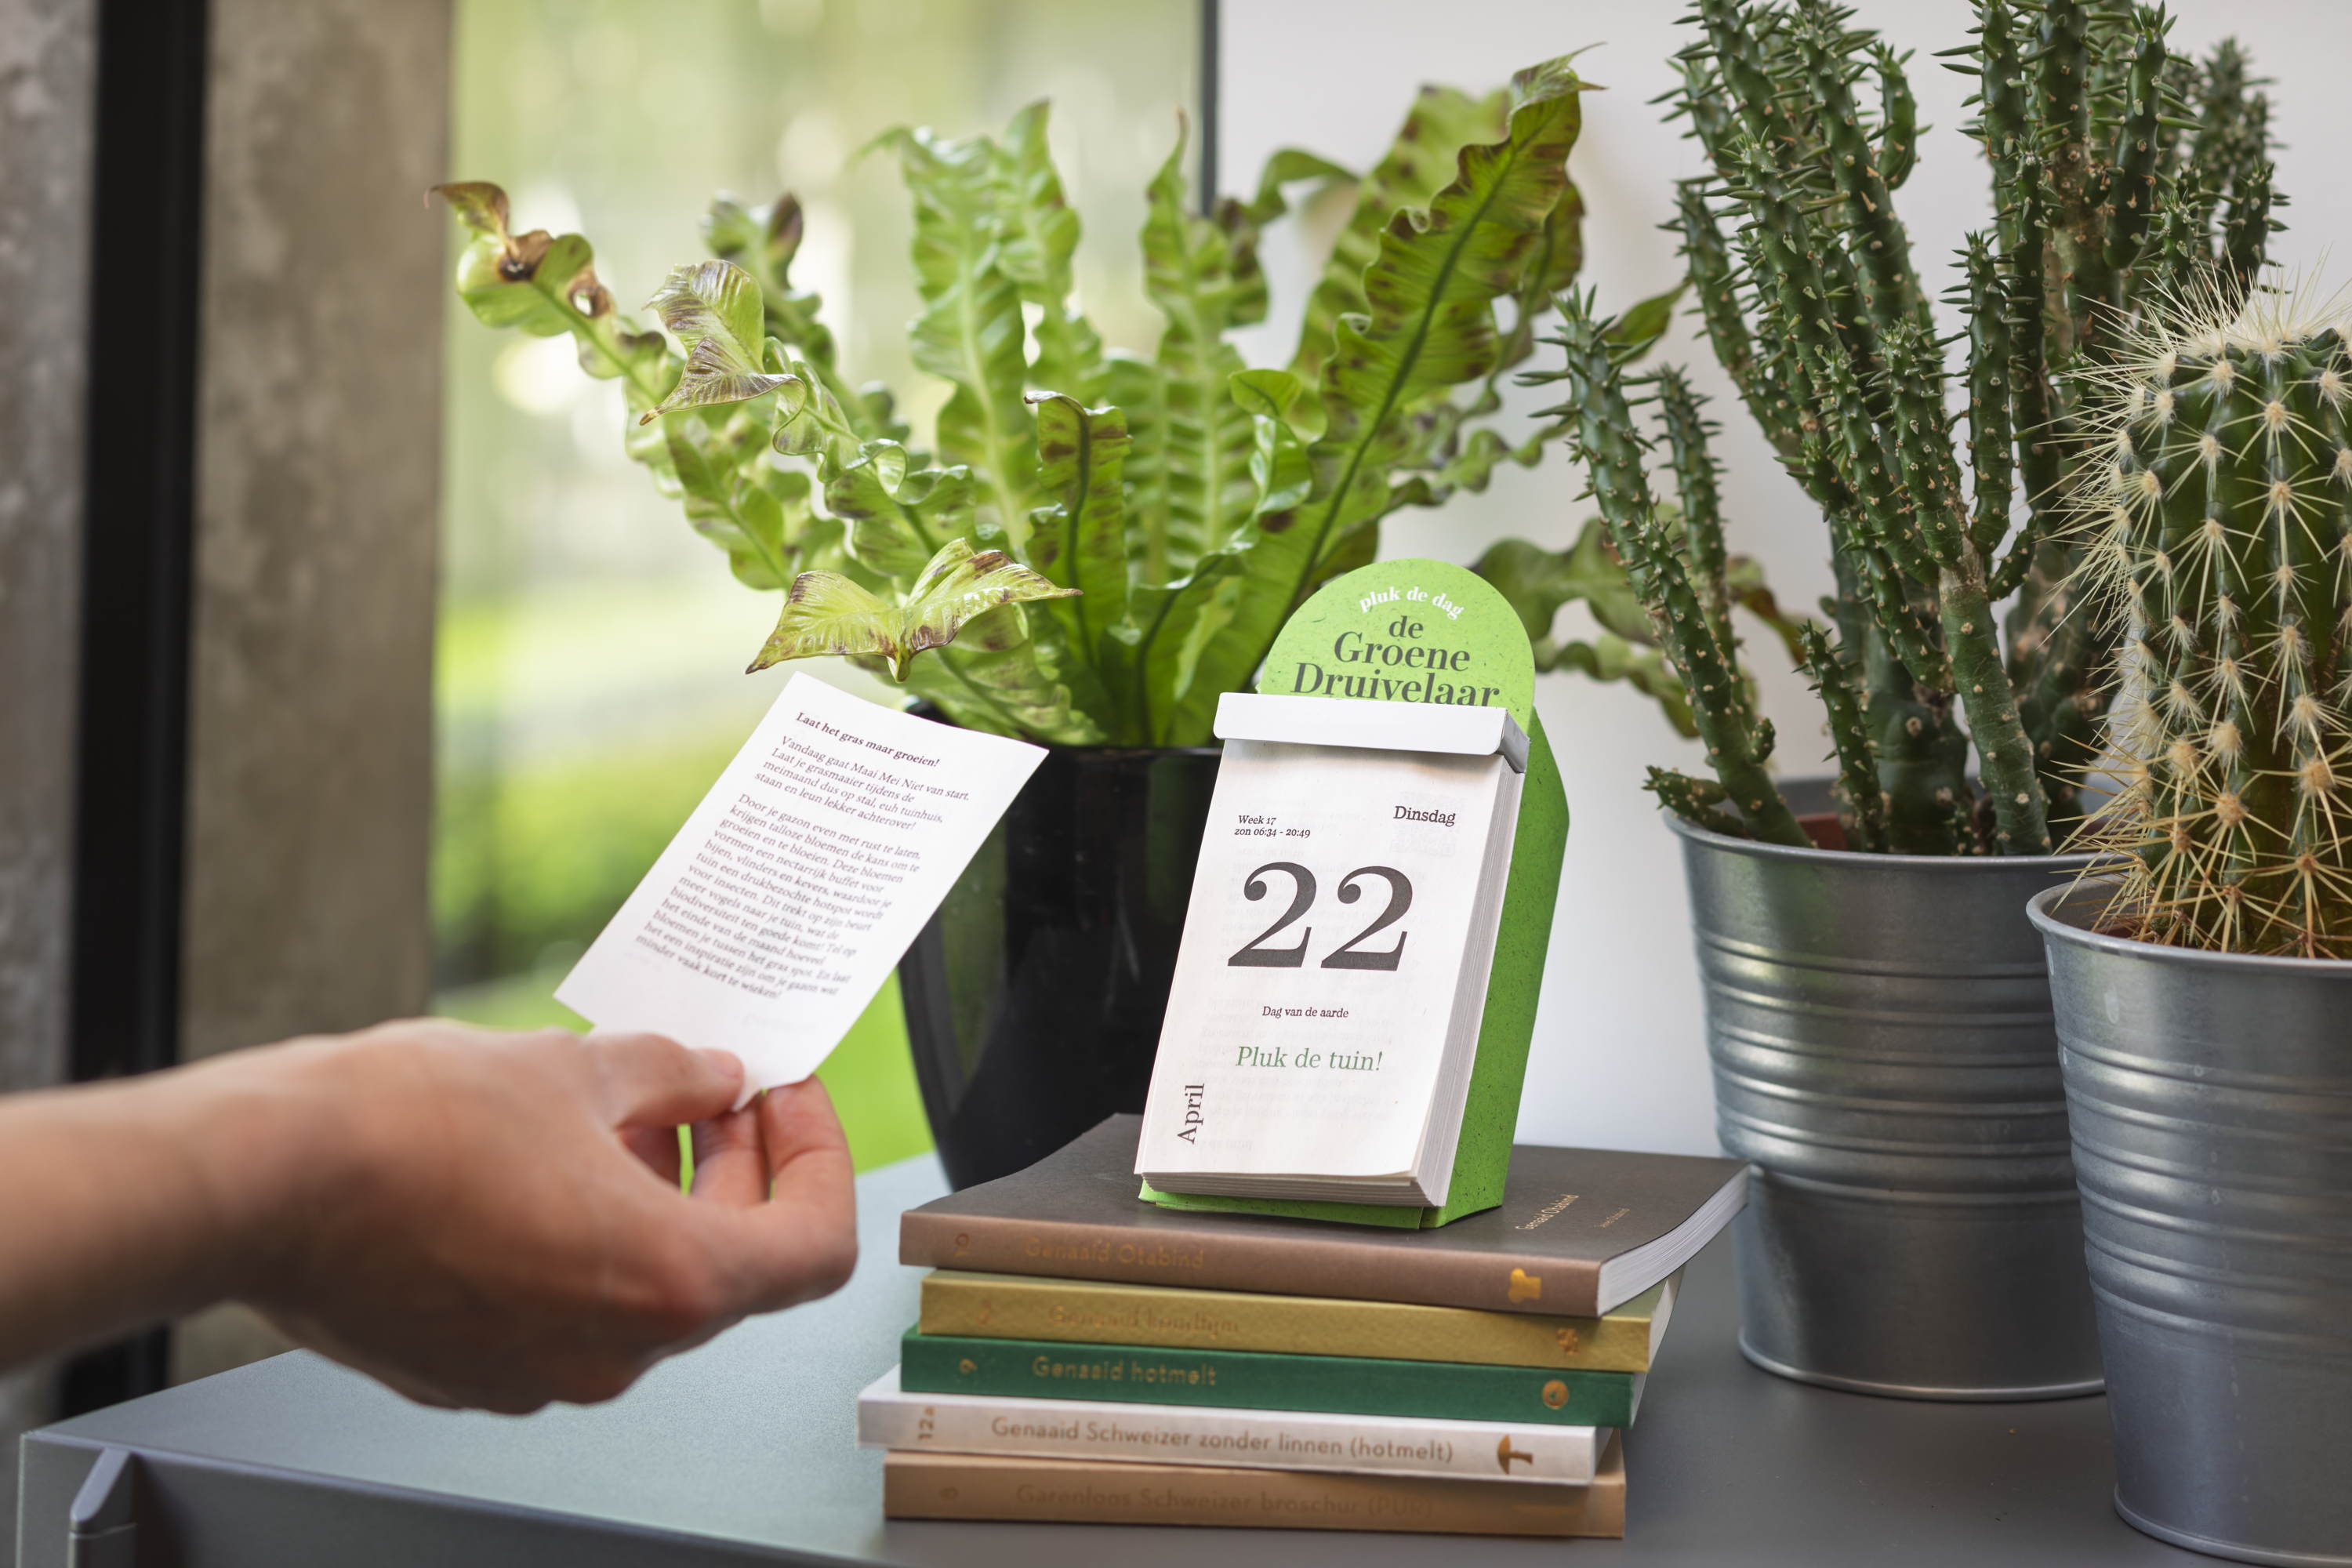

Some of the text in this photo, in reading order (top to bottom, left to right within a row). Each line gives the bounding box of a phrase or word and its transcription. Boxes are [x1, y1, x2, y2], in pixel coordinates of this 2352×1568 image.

[1359, 586, 1465, 620] pluk de dag
[1388, 615, 1424, 639] de
[1334, 631, 1471, 672] Groene
[1290, 662, 1500, 707] Druivelaar
[796, 712, 942, 767] Laat het gras maar groeien!
[764, 761, 821, 787] meimaand
[819, 780, 840, 795] dus
[840, 789, 856, 803] op
[879, 802, 901, 813] euh
[771, 747, 916, 803] Laat je grasmaaier tijdens de
[780, 735, 970, 801] Vandaag gaat Maai Mei Niet van start.
[738, 793, 768, 812] Door
[767, 805, 779, 818] je
[778, 812, 812, 829] gazon
[812, 824, 838, 838] even
[838, 833, 861, 845] met
[861, 840, 884, 851] rust
[883, 844, 895, 854] te
[755, 772, 917, 830] staan en leun lekker achterover!
[1238, 815, 1276, 826] Week 17
[1393, 805, 1457, 827] Dinsdag
[719, 818, 763, 840] groeien
[762, 836, 777, 846] en
[777, 840, 789, 851] te
[833, 858, 860, 874] Deze
[859, 866, 906, 884] bloemen
[730, 804, 920, 873] krijgen talloze bloemen de kans om te
[1253, 827, 1277, 837] 06:34
[1286, 828, 1311, 838] 20:49
[695, 852, 720, 868] tuin
[720, 863, 741, 877] een
[740, 870, 813, 904] drukbezochte
[813, 896, 855, 915] hotspot
[713, 830, 885, 893] vormen een nectarrijk buffet voor
[735, 855, 780, 877] vlinders
[833, 890, 882, 906] waardoor
[670, 885, 742, 924] biodiversiteit
[741, 917, 760, 931] ten
[758, 926, 793, 942] goede
[679, 877, 708, 894] meer
[708, 890, 742, 909] vogels
[742, 904, 768, 919] naar
[688, 865, 714, 881] voor
[763, 894, 782, 908] Dit
[782, 902, 810, 917] trekt
[1227, 862, 1414, 971] 22
[644, 920, 664, 937] het
[663, 932, 684, 948] een
[684, 940, 736, 969] inspiratie
[652, 909, 701, 938] bloemen
[712, 938, 748, 958] tussen
[748, 950, 768, 965] het
[764, 960, 790, 972] gras
[661, 898, 682, 913] het
[681, 908, 712, 927] einde
[712, 923, 733, 937] van
[748, 938, 788, 956] maand
[636, 935, 677, 959] minder
[677, 954, 705, 971] vaak
[703, 964, 729, 982] kort
[1262, 1006, 1349, 1018] Dag van de aarde
[1236, 1046, 1383, 1071] Pluk de tuin!
[1177, 1083, 1205, 1145] April
[1025, 1236, 1205, 1269] Genaaid Otabind
[1032, 1356, 1217, 1386] Genaaid hotmelt
[991, 1416, 1454, 1463] Genaaid Schweizer zonder linnen (hotmelt)
[1015, 1483, 1131, 1508] Garenloos
[1139, 1487, 1251, 1513] Schweizer
